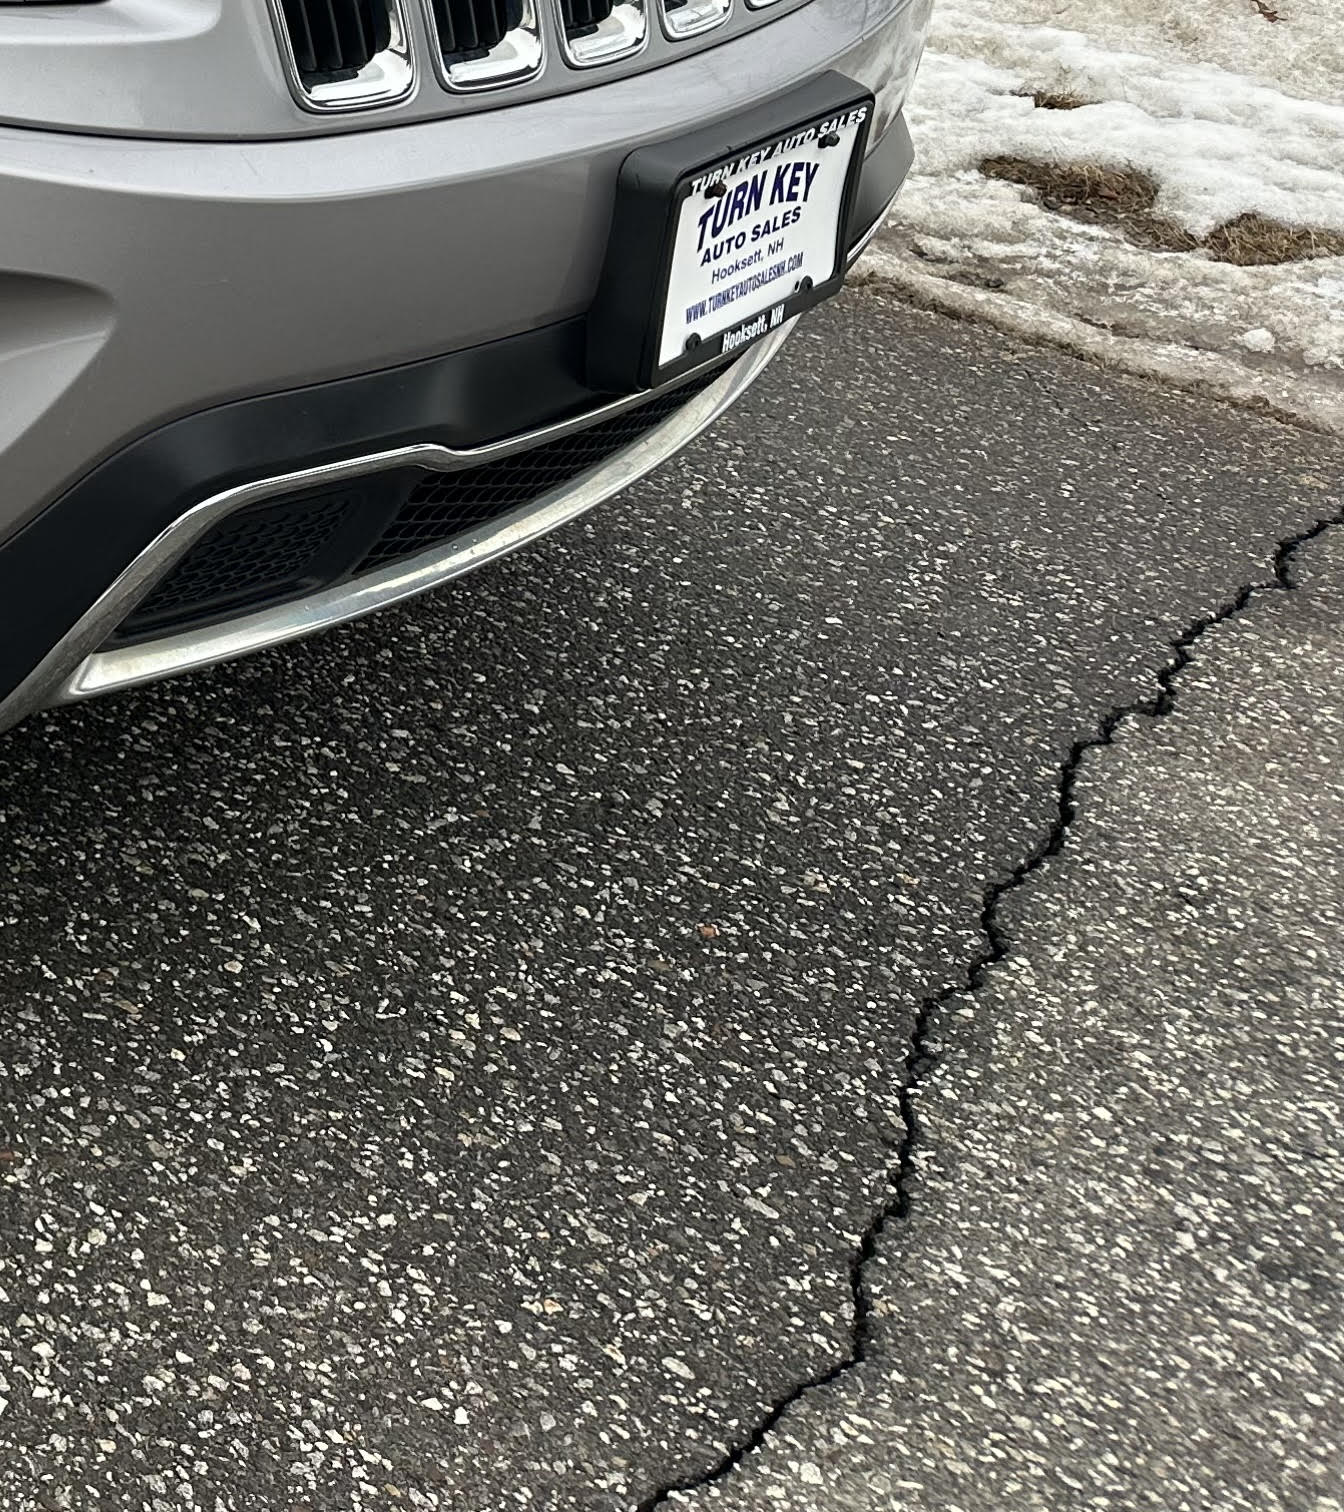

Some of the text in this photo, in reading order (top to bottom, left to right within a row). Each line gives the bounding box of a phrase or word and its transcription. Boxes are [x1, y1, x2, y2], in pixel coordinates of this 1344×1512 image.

[691, 106, 868, 196] TURN KEY AUTO SALES
[697, 161, 820, 254] TURN KEY
[700, 206, 802, 267] AUTO SALES
[767, 237, 785, 257] NH
[770, 303, 785, 329] NH
